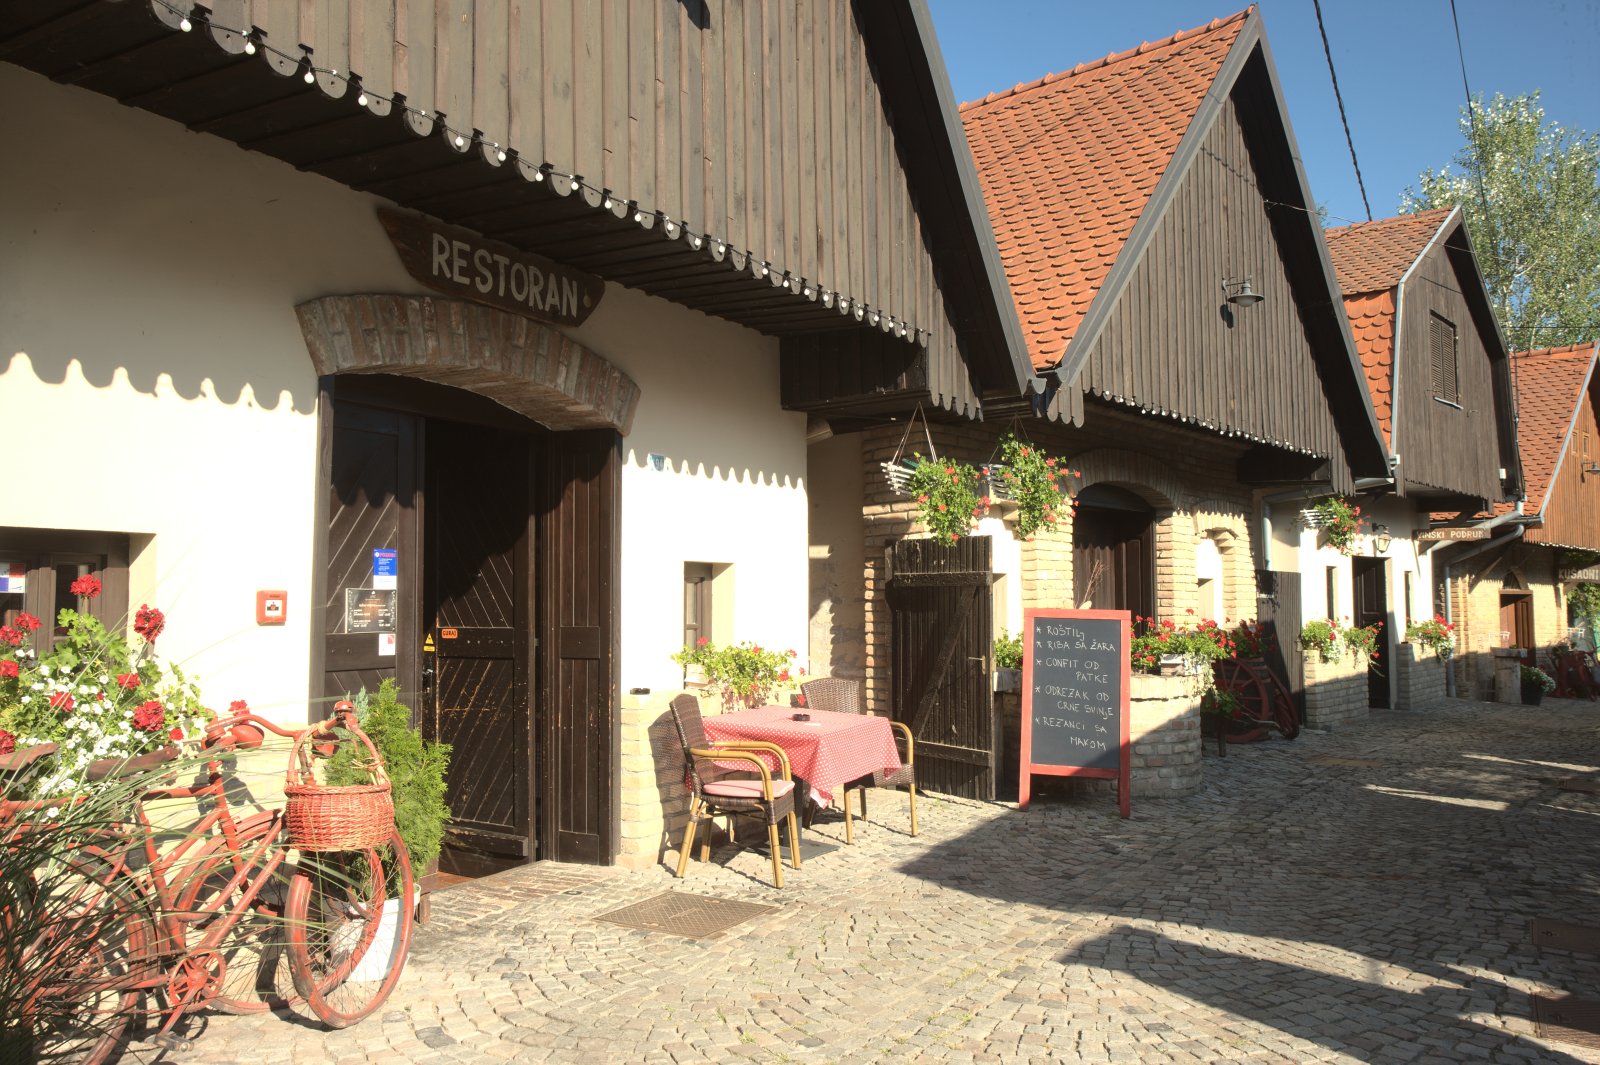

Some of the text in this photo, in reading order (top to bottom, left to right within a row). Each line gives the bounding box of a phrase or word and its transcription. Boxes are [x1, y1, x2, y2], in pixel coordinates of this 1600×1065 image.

[432, 232, 579, 318] RESTORAN
[1046, 624, 1085, 642] ROŠTILJ
[1047, 638, 1116, 652] RIBA SA ŽARA
[1045, 657, 1100, 670] CONFIT OD
[1075, 671, 1109, 684] PATKE
[1044, 684, 1110, 702] ODREZAK OD
[1057, 700, 1080, 713] CRNE
[1042, 716, 1108, 734] REZANCI SA
[1070, 736, 1107, 752] MAKOM
